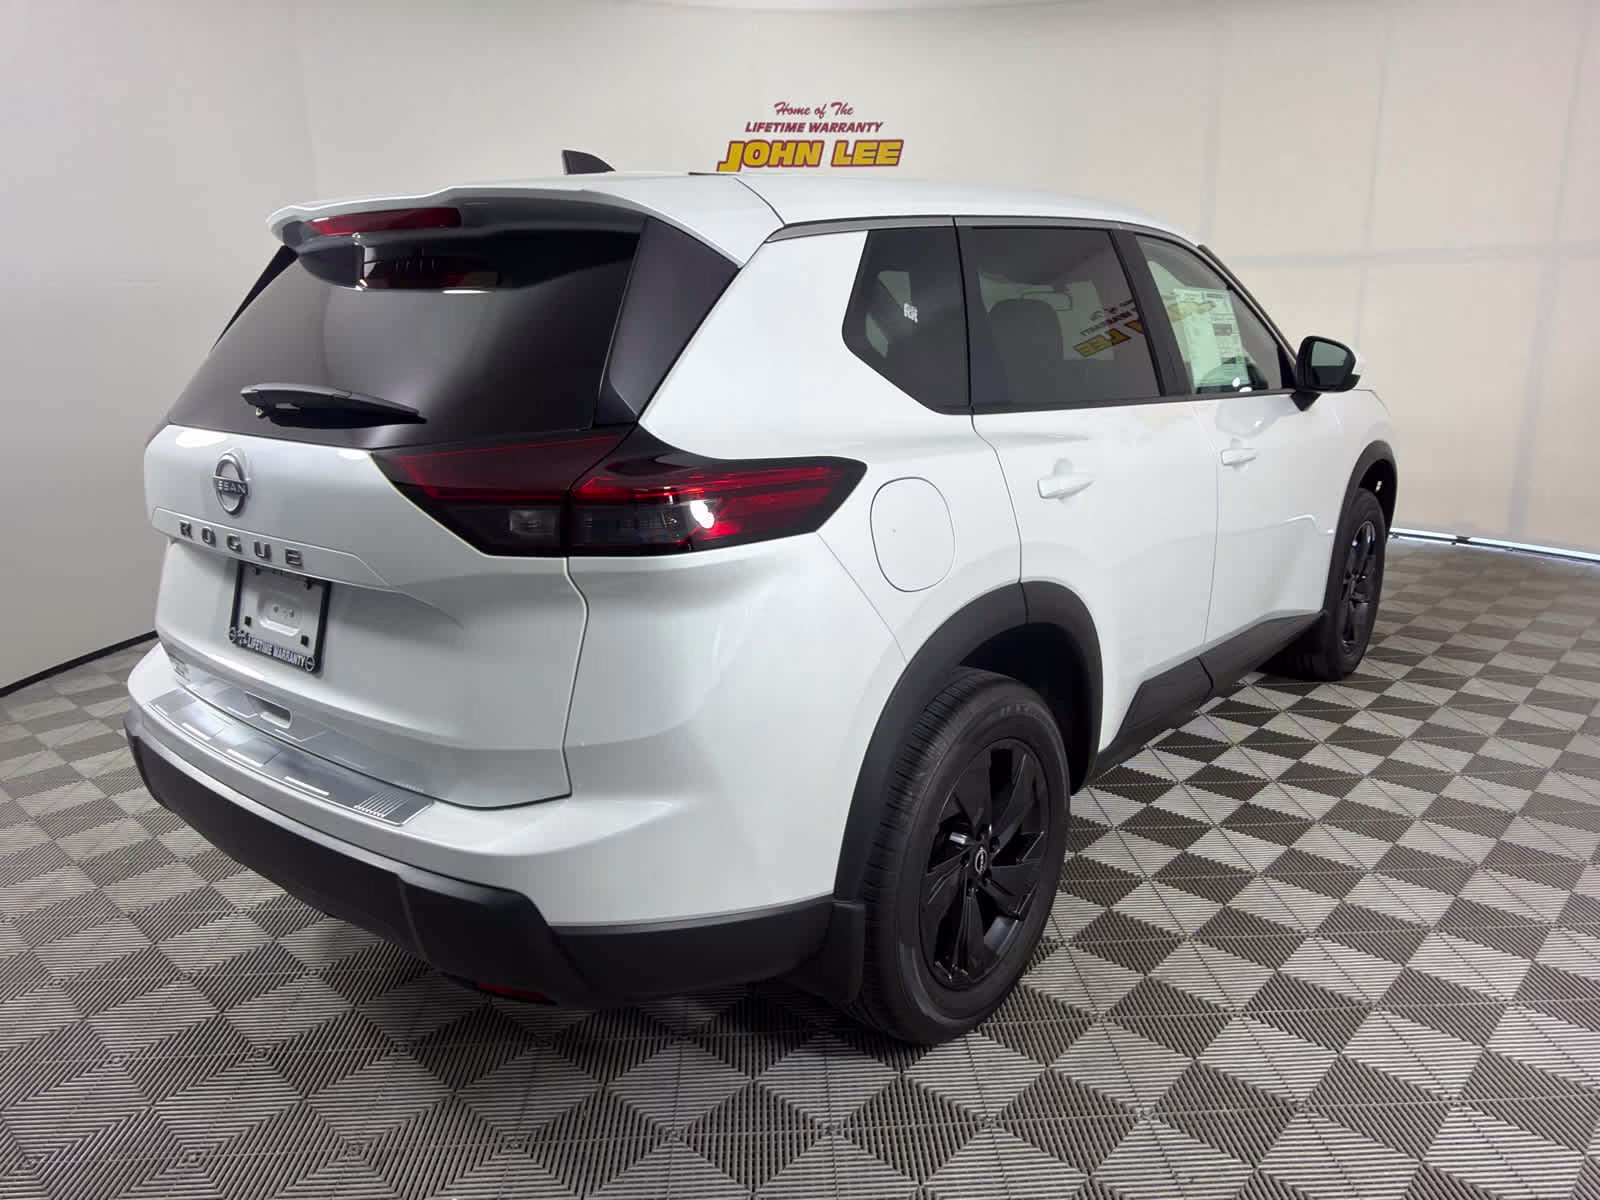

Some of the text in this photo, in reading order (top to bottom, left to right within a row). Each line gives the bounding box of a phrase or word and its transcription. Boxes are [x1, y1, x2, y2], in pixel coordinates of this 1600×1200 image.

[774, 101, 853, 119] Home of The
[745, 121, 883, 133] LIFETIME WARRANTY
[716, 139, 904, 172] JOHN LEE
[179, 519, 303, 568] ROGUE
[247, 634, 306, 667] LIFETIME WARRANTY
